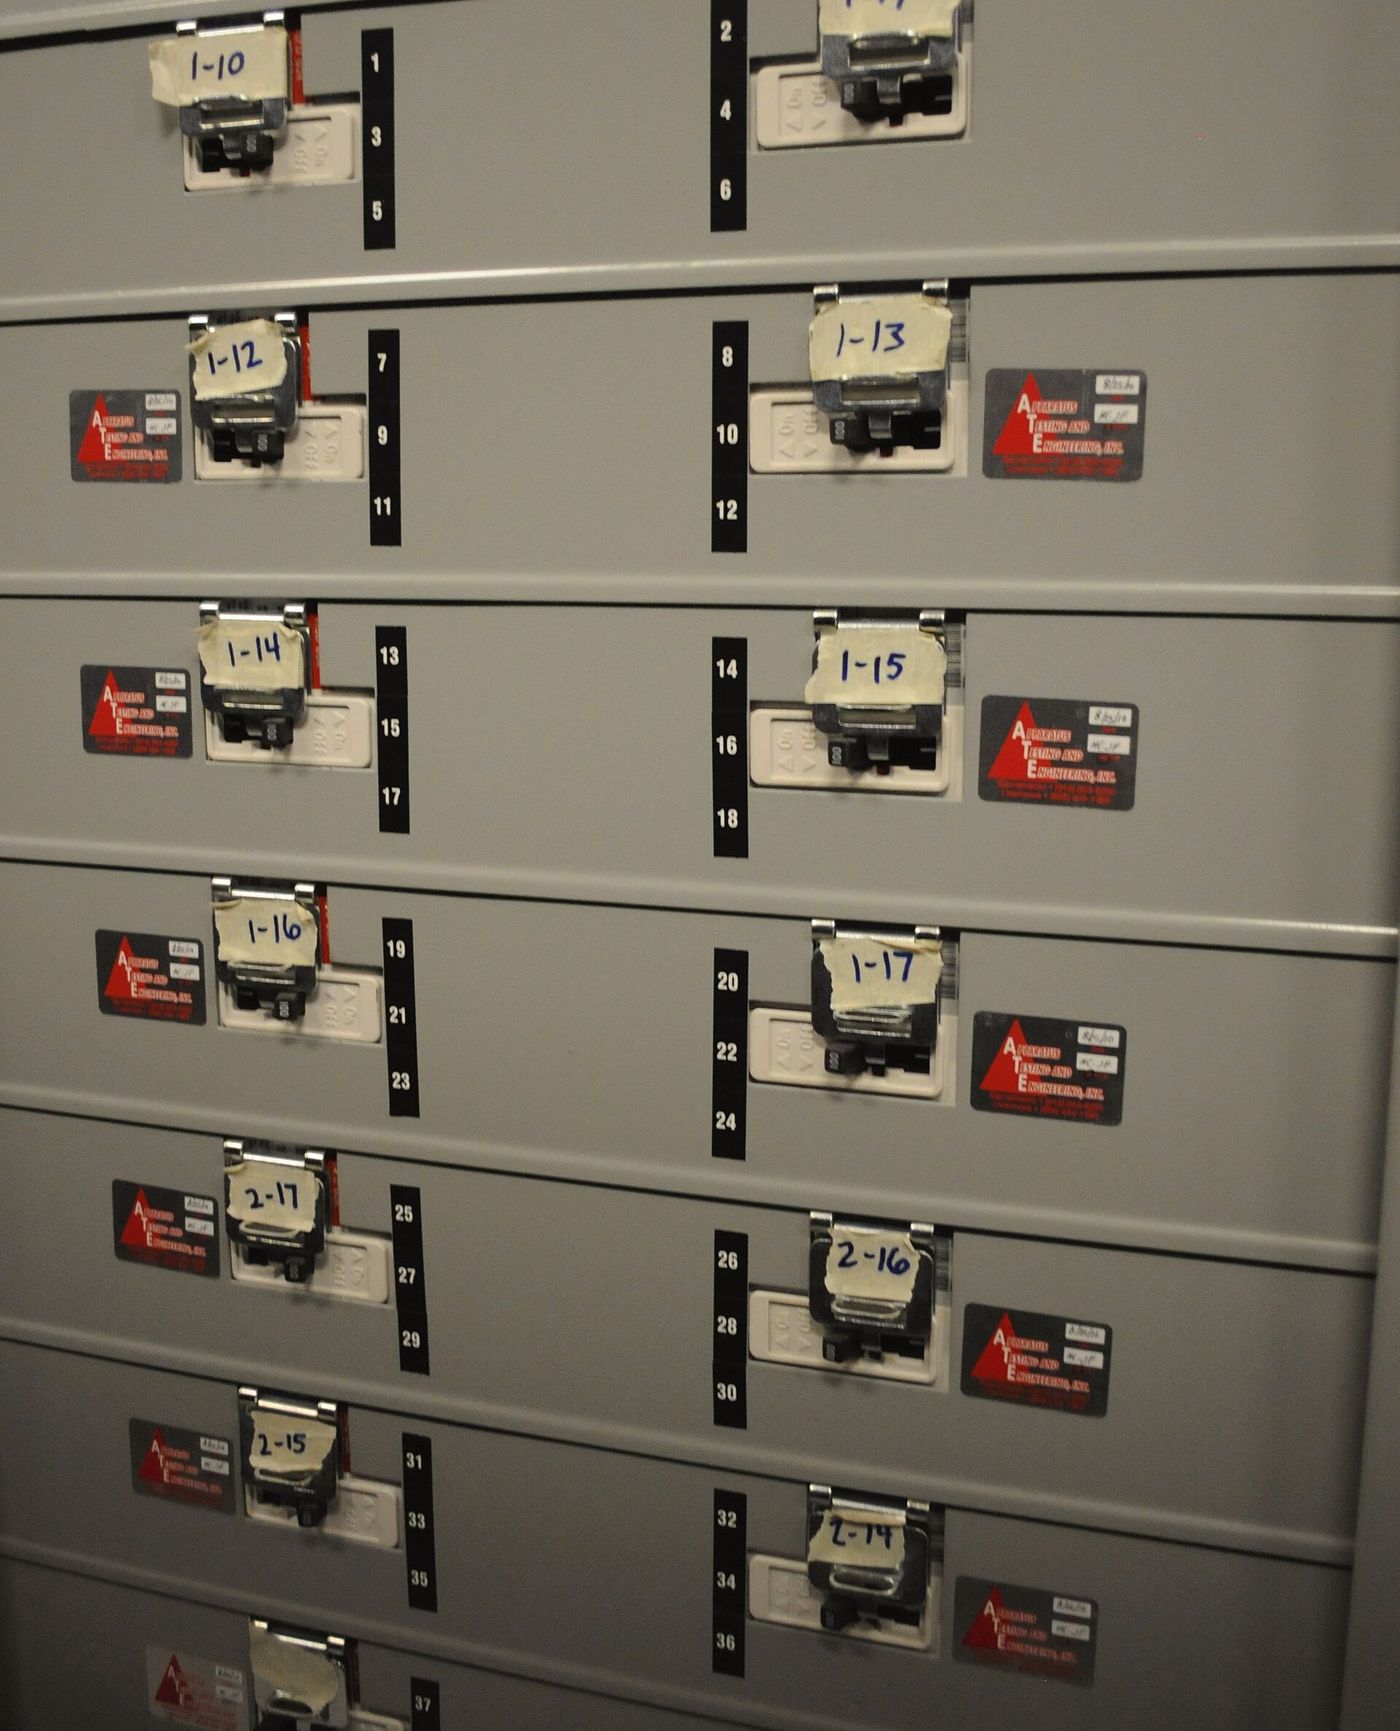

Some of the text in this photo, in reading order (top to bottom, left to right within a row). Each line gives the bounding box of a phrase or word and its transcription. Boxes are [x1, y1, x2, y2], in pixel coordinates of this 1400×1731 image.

[720, 20, 732, 42] 2
[192, 51, 245, 80] 1-10
[371, 53, 380, 72] 1
[720, 100, 731, 120] 4
[372, 126, 382, 147] 3
[720, 179, 731, 200] 6
[372, 201, 382, 221] 5
[836, 320, 905, 357] 1-13
[207, 341, 263, 375] 1-12
[377, 353, 387, 372] 7
[721, 346, 733, 367] 8
[378, 425, 388, 445] 9
[717, 424, 738, 444] 10
[374, 497, 392, 515] 11
[717, 500, 738, 520] 12
[228, 631, 281, 667] 1-14
[380, 646, 400, 665] 13
[717, 659, 738, 678] 14
[841, 650, 906, 684] 1-15
[381, 718, 401, 737] 15
[717, 735, 738, 755] 16
[383, 787, 401, 805] 17
[717, 809, 739, 828] 18
[248, 914, 302, 944] 1-16
[387, 940, 406, 958] 19
[852, 951, 914, 983] 1-17
[718, 972, 739, 991] 20
[389, 1006, 406, 1024] 21
[717, 1042, 738, 1061] 22
[392, 1072, 411, 1090] 23
[717, 1111, 737, 1131] 24
[245, 1181, 298, 1209] 2-17
[395, 1204, 414, 1222] 25
[718, 1251, 739, 1270] 26
[837, 1241, 911, 1275] 2-16
[398, 1267, 416, 1284] 27
[718, 1316, 738, 1335] 28
[403, 1331, 421, 1348] 29
[717, 1383, 737, 1401] 30
[257, 1433, 307, 1456] 2-15
[406, 1453, 422, 1469] 31
[408, 1512, 426, 1529] 33
[717, 1510, 737, 1527] 32
[829, 1514, 893, 1549] 2-14
[411, 1571, 428, 1587] 35
[717, 1572, 736, 1589] 34
[717, 1634, 736, 1651] 36
[415, 1695, 431, 1712] 37
